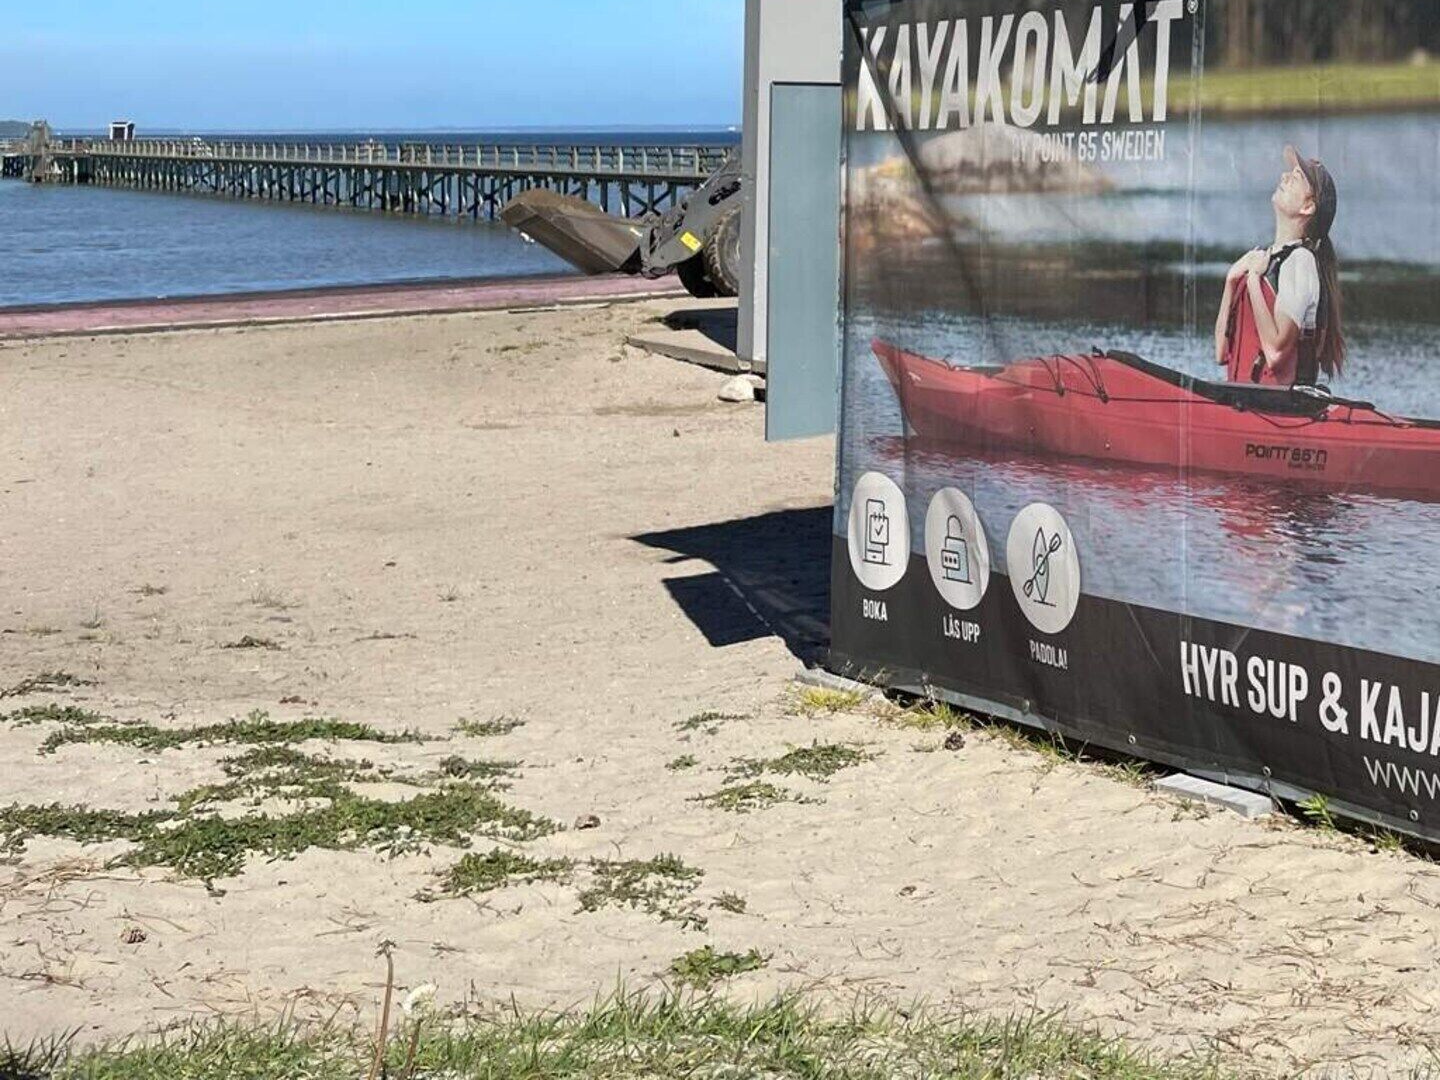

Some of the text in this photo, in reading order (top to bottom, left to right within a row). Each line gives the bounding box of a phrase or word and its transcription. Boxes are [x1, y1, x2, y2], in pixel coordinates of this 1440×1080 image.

[1032, 132, 1075, 163] POINT
[1078, 130, 1099, 162] 65
[1101, 129, 1166, 161] SWEDEN
[862, 598, 888, 622] BOKA
[942, 615, 980, 644] LÅS UPP
[1029, 639, 1068, 670] PADDLA!
[1180, 640, 1240, 708] HYR
[1247, 655, 1309, 722] SUP
[1318, 671, 1349, 735] &
